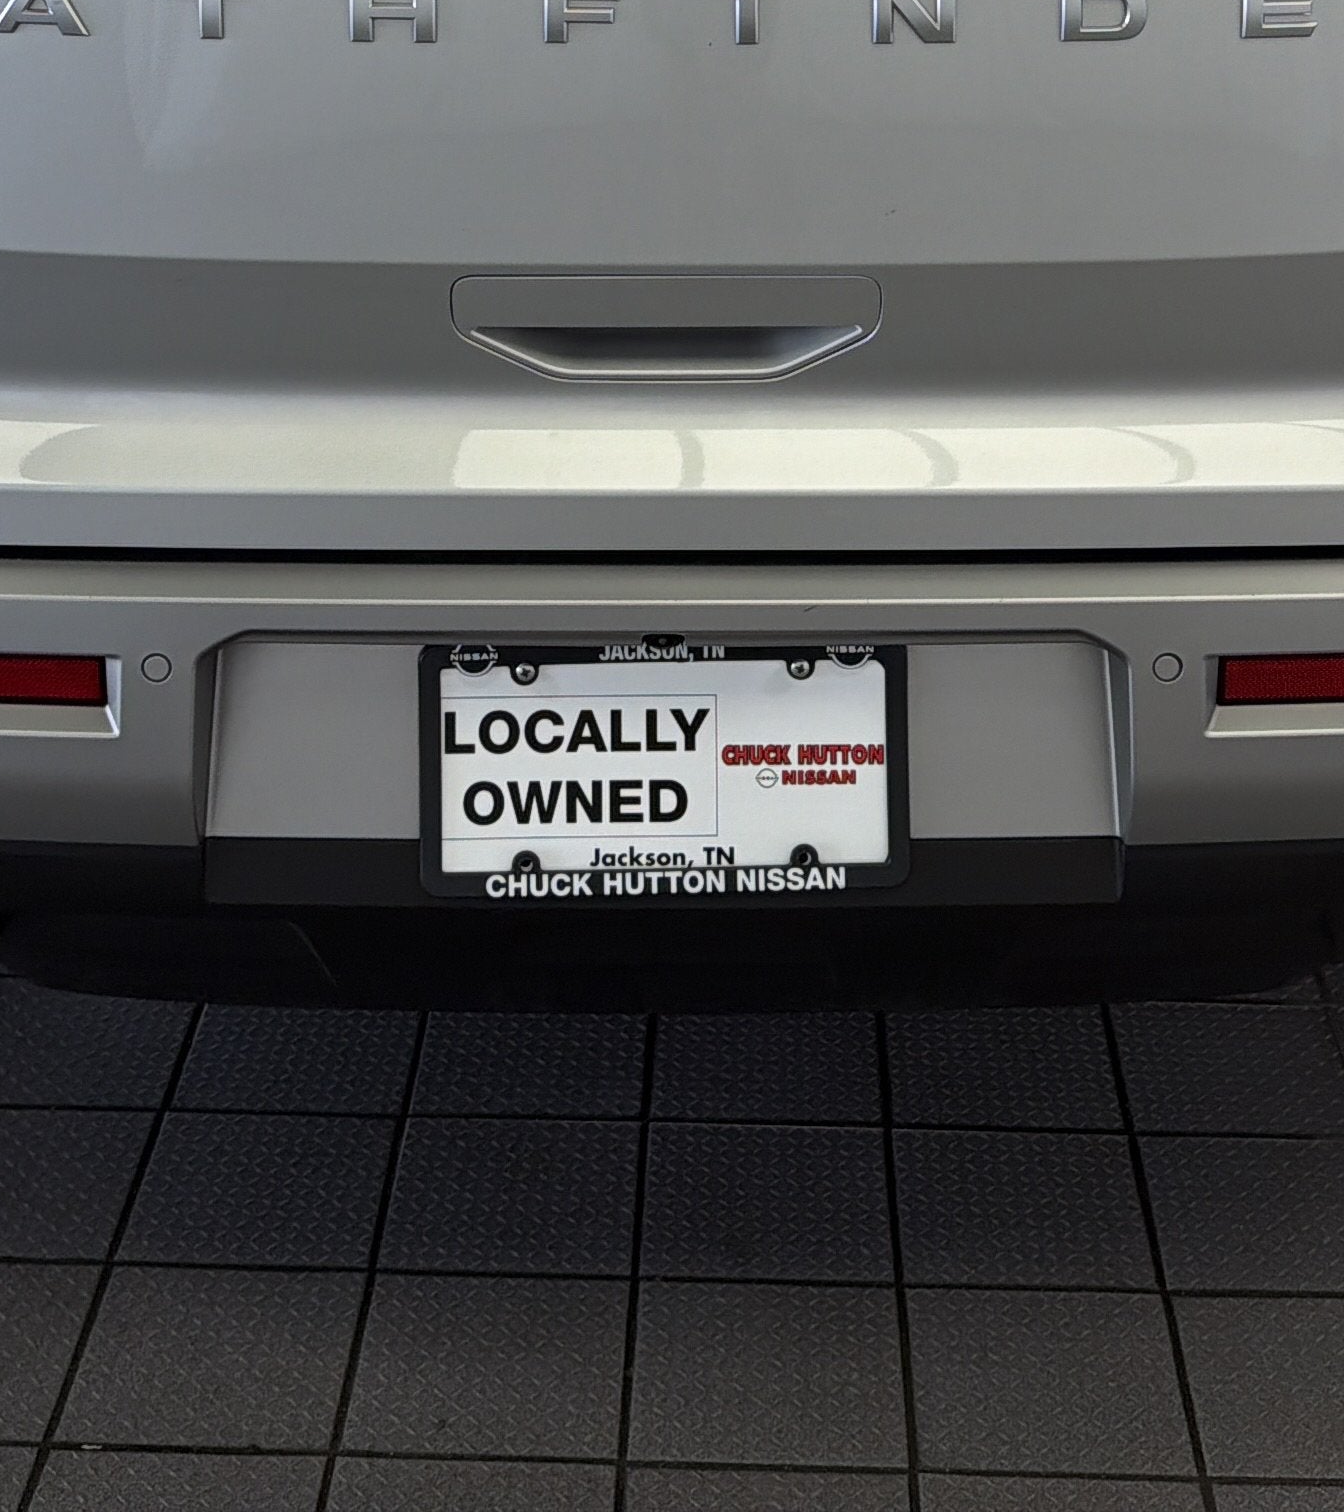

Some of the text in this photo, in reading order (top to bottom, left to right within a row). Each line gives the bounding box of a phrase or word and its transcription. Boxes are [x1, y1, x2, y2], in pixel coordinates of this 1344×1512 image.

[449, 652, 498, 661] NISSAN
[826, 645, 875, 654] NISSAN
[444, 708, 710, 755] LOCALLY
[721, 744, 884, 765] CHUCK HUTTON
[781, 770, 856, 785] NISSAN
[462, 779, 688, 825] OWNED
[590, 846, 735, 869] Jackson, TN
[485, 866, 846, 898] CHUCK HUTTON NISSAN
